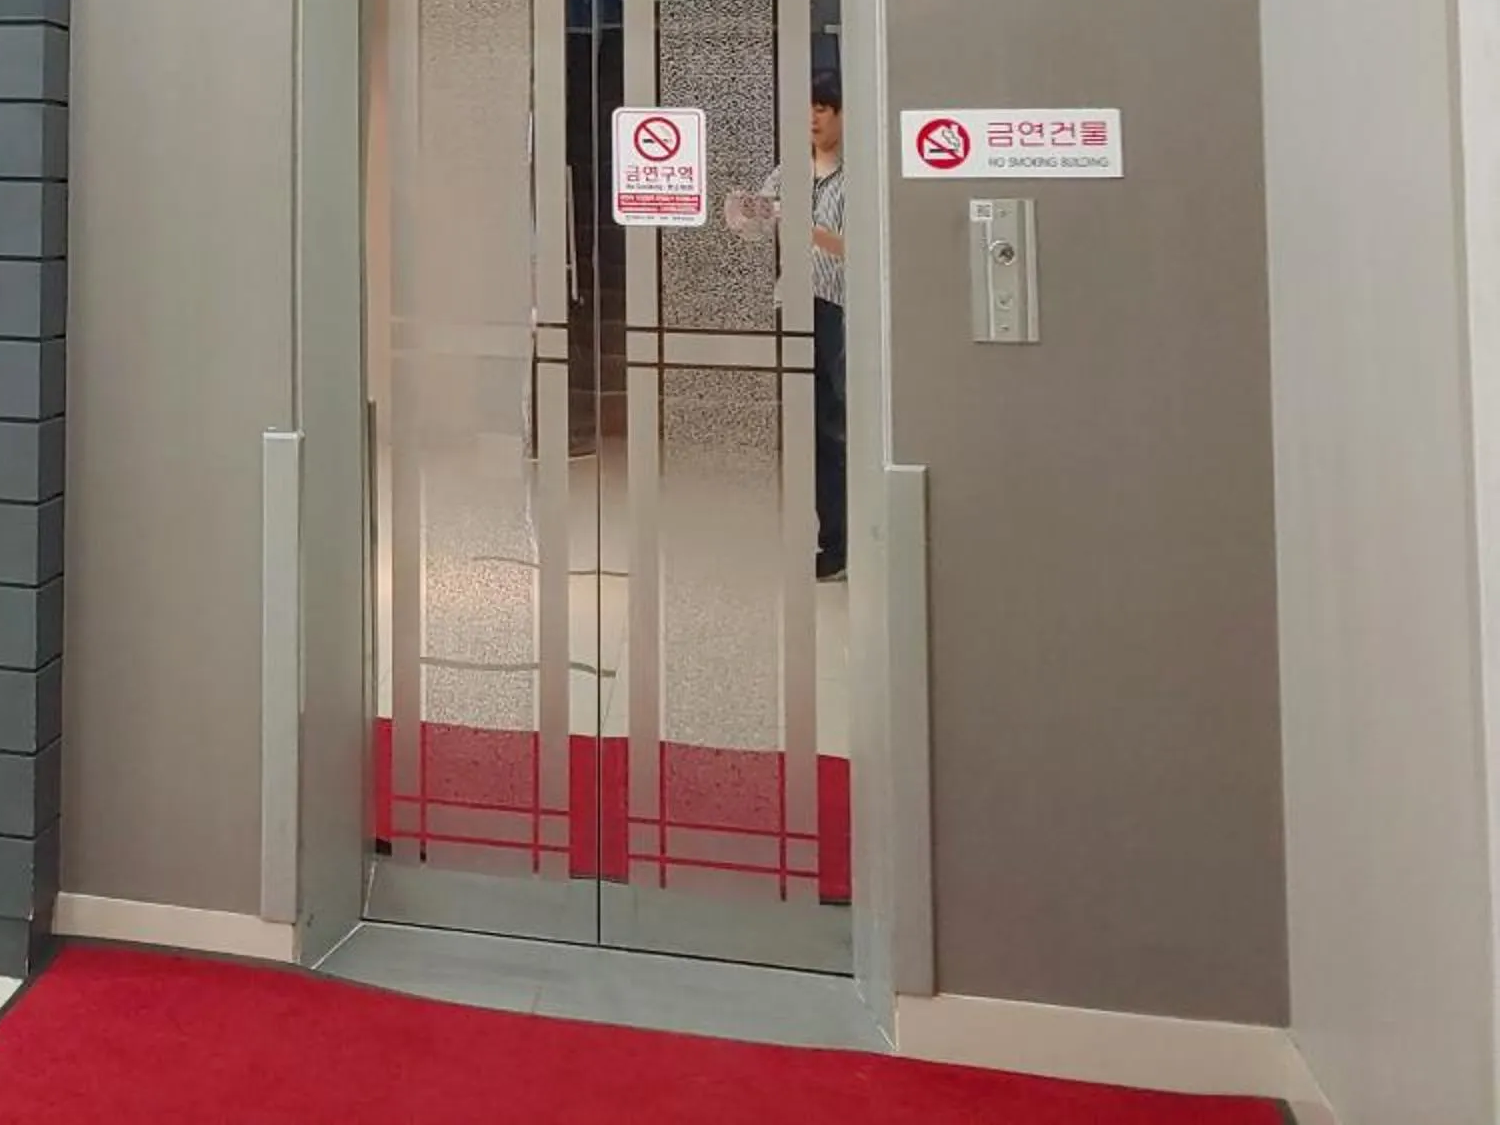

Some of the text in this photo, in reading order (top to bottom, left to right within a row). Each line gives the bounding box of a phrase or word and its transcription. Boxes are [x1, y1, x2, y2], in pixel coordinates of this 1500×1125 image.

[987, 120, 1109, 148] 금연건물
[987, 156, 1006, 168] NO
[1008, 156, 1058, 168] SMOKING
[625, 165, 694, 182] 금연구역
